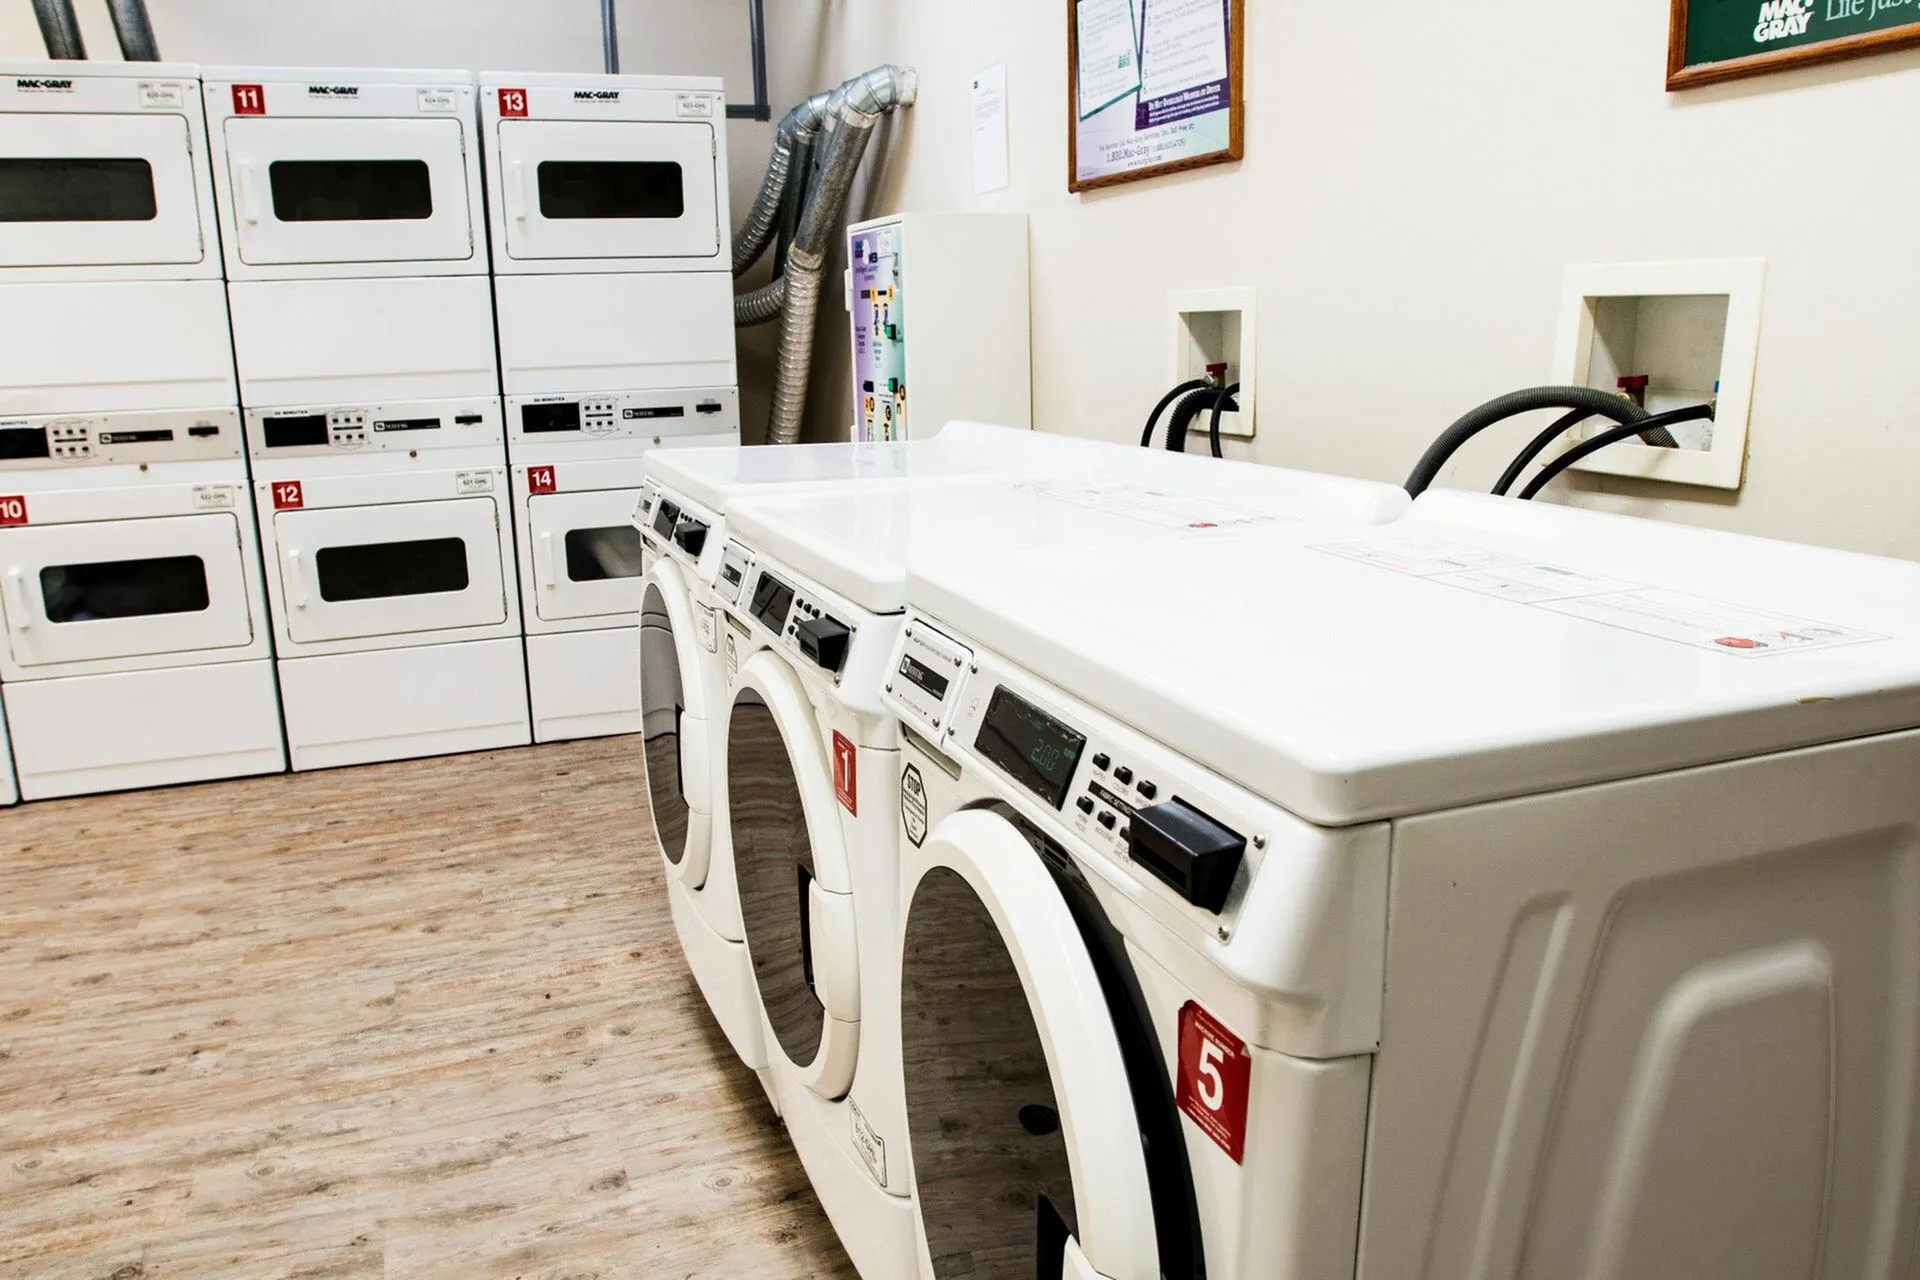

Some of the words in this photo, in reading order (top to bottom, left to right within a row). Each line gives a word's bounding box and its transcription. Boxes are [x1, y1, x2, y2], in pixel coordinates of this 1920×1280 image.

[1753, 11, 1815, 43] GRAY
[237, 90, 258, 108] 11
[503, 93, 525, 110] 13
[532, 470, 551, 487] 14
[277, 486, 299, 503] 12
[0, 500, 22, 518] 10
[842, 749, 849, 793] 1
[1197, 1036, 1224, 1111] 5
